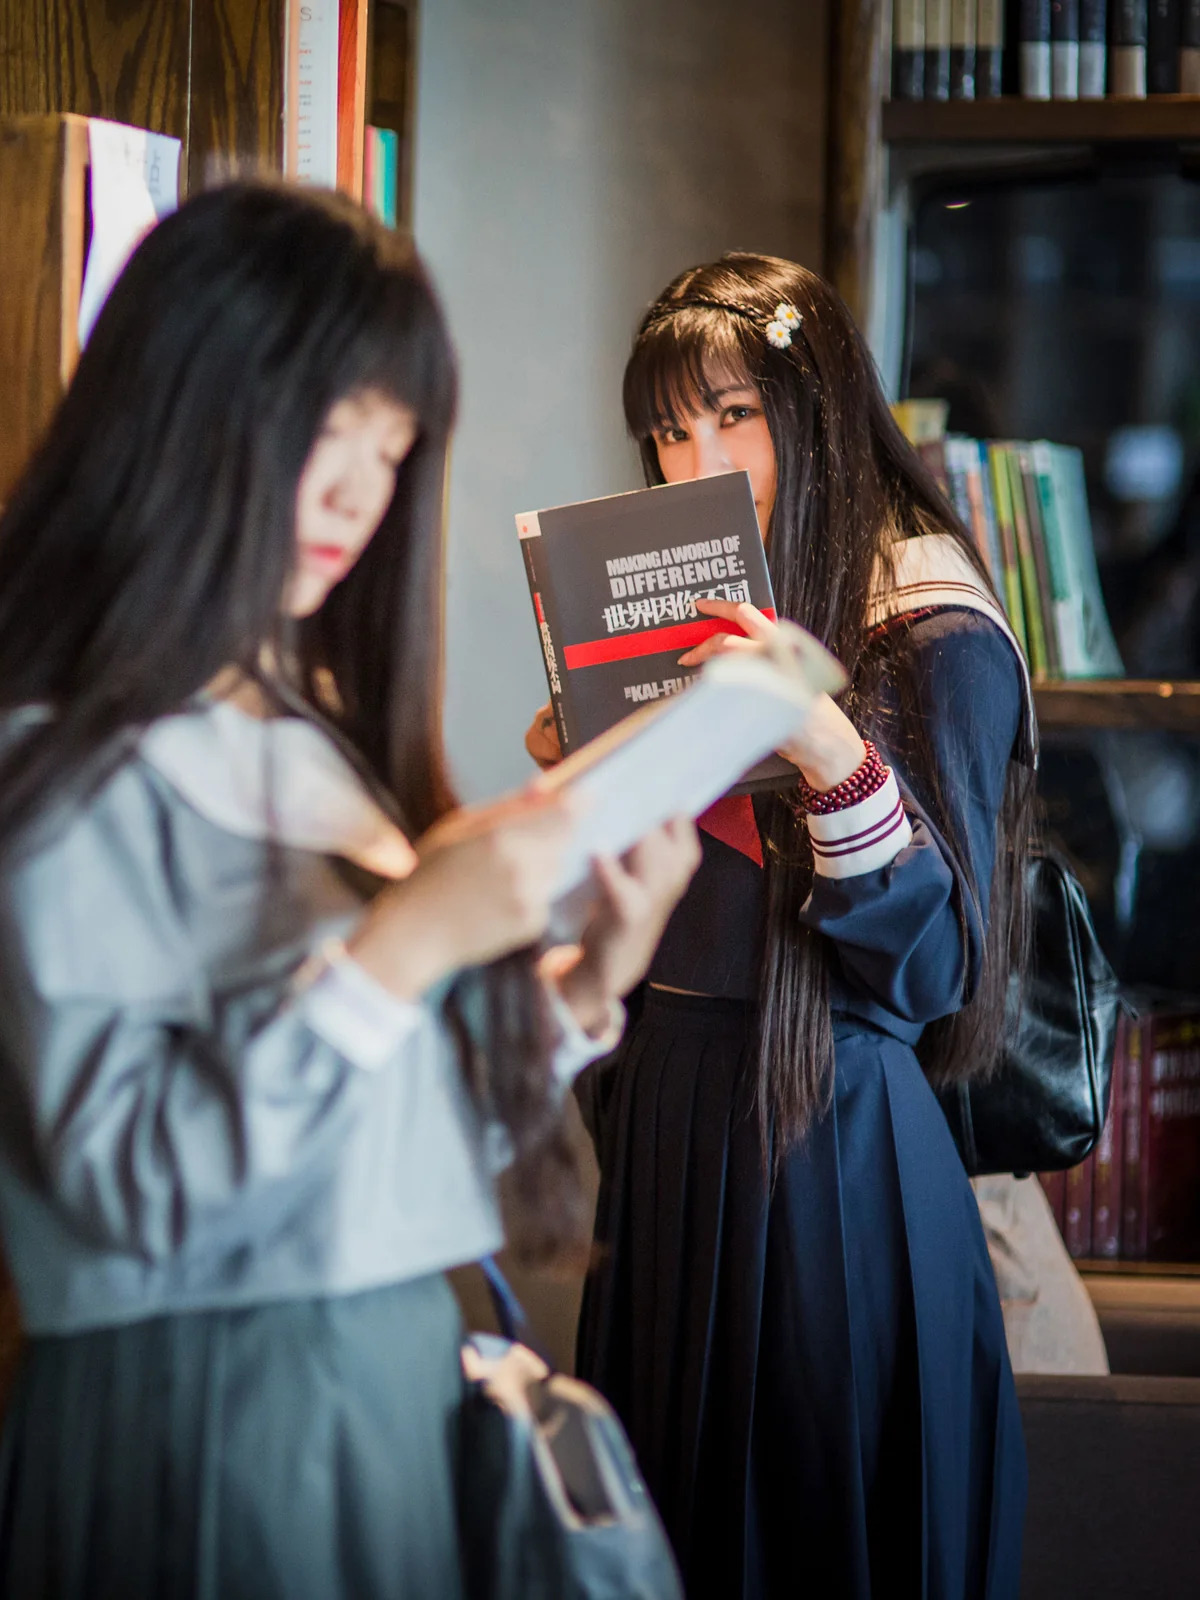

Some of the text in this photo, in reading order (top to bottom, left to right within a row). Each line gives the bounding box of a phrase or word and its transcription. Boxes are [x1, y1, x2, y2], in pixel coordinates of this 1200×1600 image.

[605, 534, 741, 577] MAKING A WORLD OF
[609, 554, 747, 600] DIFFERENCE:
